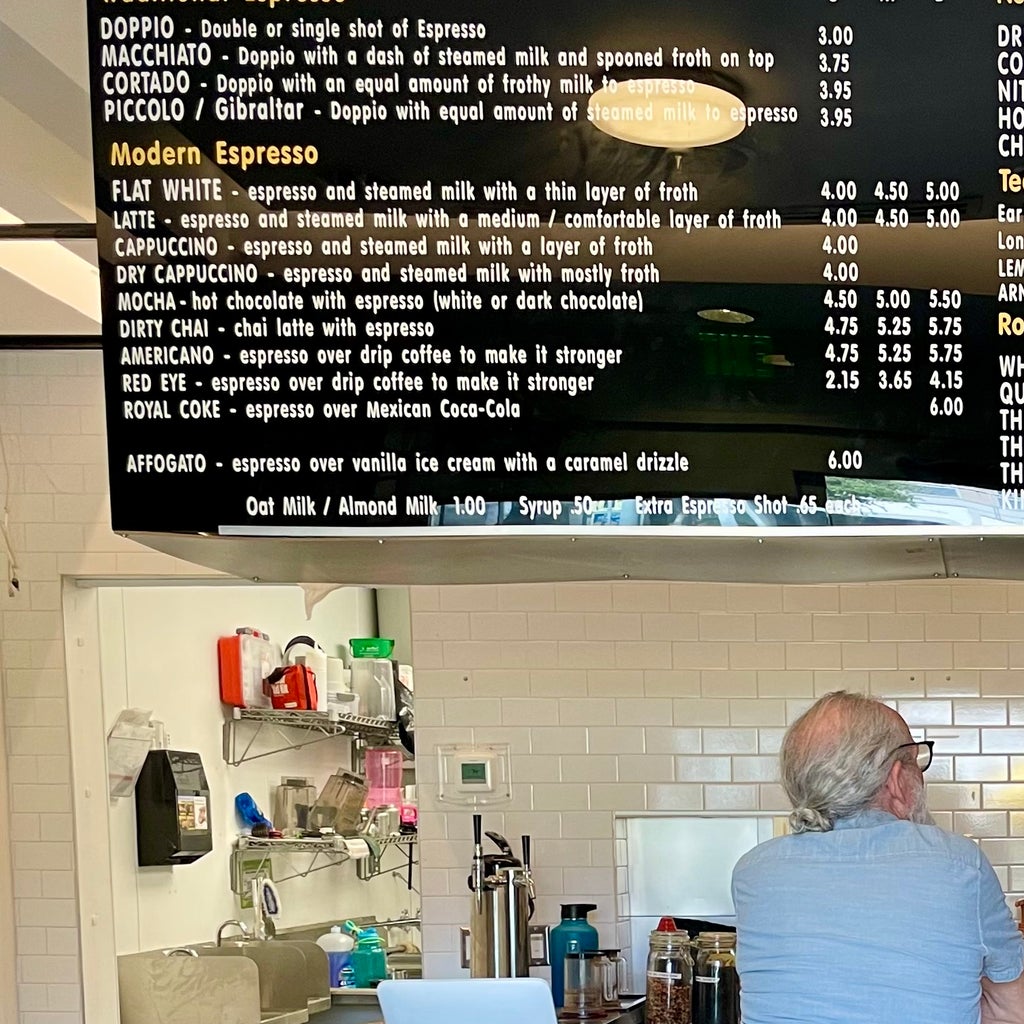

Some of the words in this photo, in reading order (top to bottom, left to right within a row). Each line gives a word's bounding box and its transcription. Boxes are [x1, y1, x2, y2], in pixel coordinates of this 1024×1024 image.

[101, 16, 174, 39] DOPPIO
[202, 18, 256, 37] Double
[267, 23, 282, 37] or
[292, 18, 339, 42] single
[350, 18, 383, 37] shot
[393, 18, 408, 37] of
[418, 19, 485, 43] Espresso
[819, 26, 852, 45] 3.00
[102, 43, 211, 66] MACCHIATO
[239, 45, 294, 69] Doppio
[304, 45, 337, 64] with
[348, 51, 356, 64] a
[367, 46, 403, 65] dash
[414, 46, 429, 65] of
[439, 46, 505, 65] steamed
[516, 46, 549, 65] milk
[558, 47, 587, 66] and
[597, 47, 662, 71] spooned
[672, 47, 710, 66] froth
[721, 53, 739, 67] on
[749, 49, 774, 72] top
[820, 53, 849, 72] 3.75
[112, 140, 200, 165] Modern
[216, 141, 318, 170] Espresso
[120, 320, 162, 337] DIRTY
[172, 319, 208, 337] CHAI
[235, 317, 267, 337] chai
[277, 318, 313, 336] latte
[323, 317, 356, 336] with
[366, 322, 434, 341] espresso
[825, 317, 858, 335] 4.75
[878, 317, 910, 335] 5.25
[929, 317, 961, 335] 5.75
[124, 401, 171, 419] ROYAL
[180, 400, 220, 418] COKE
[246, 404, 314, 422] espresso
[324, 404, 357, 418] over
[367, 399, 431, 418] Mexican
[441, 398, 520, 417] Coca-Cola
[930, 397, 963, 415] 6.00
[128, 454, 206, 472] AFFOGATO
[233, 458, 300, 476] espresso
[310, 458, 343, 471] over
[353, 452, 406, 471] vanilla
[416, 452, 438, 471] ice
[448, 457, 495, 471] cream
[504, 452, 537, 471] with
[547, 457, 555, 471] a
[565, 452, 627, 471] caramel
[637, 452, 688, 471] drizzle
[829, 451, 862, 469] 6.00
